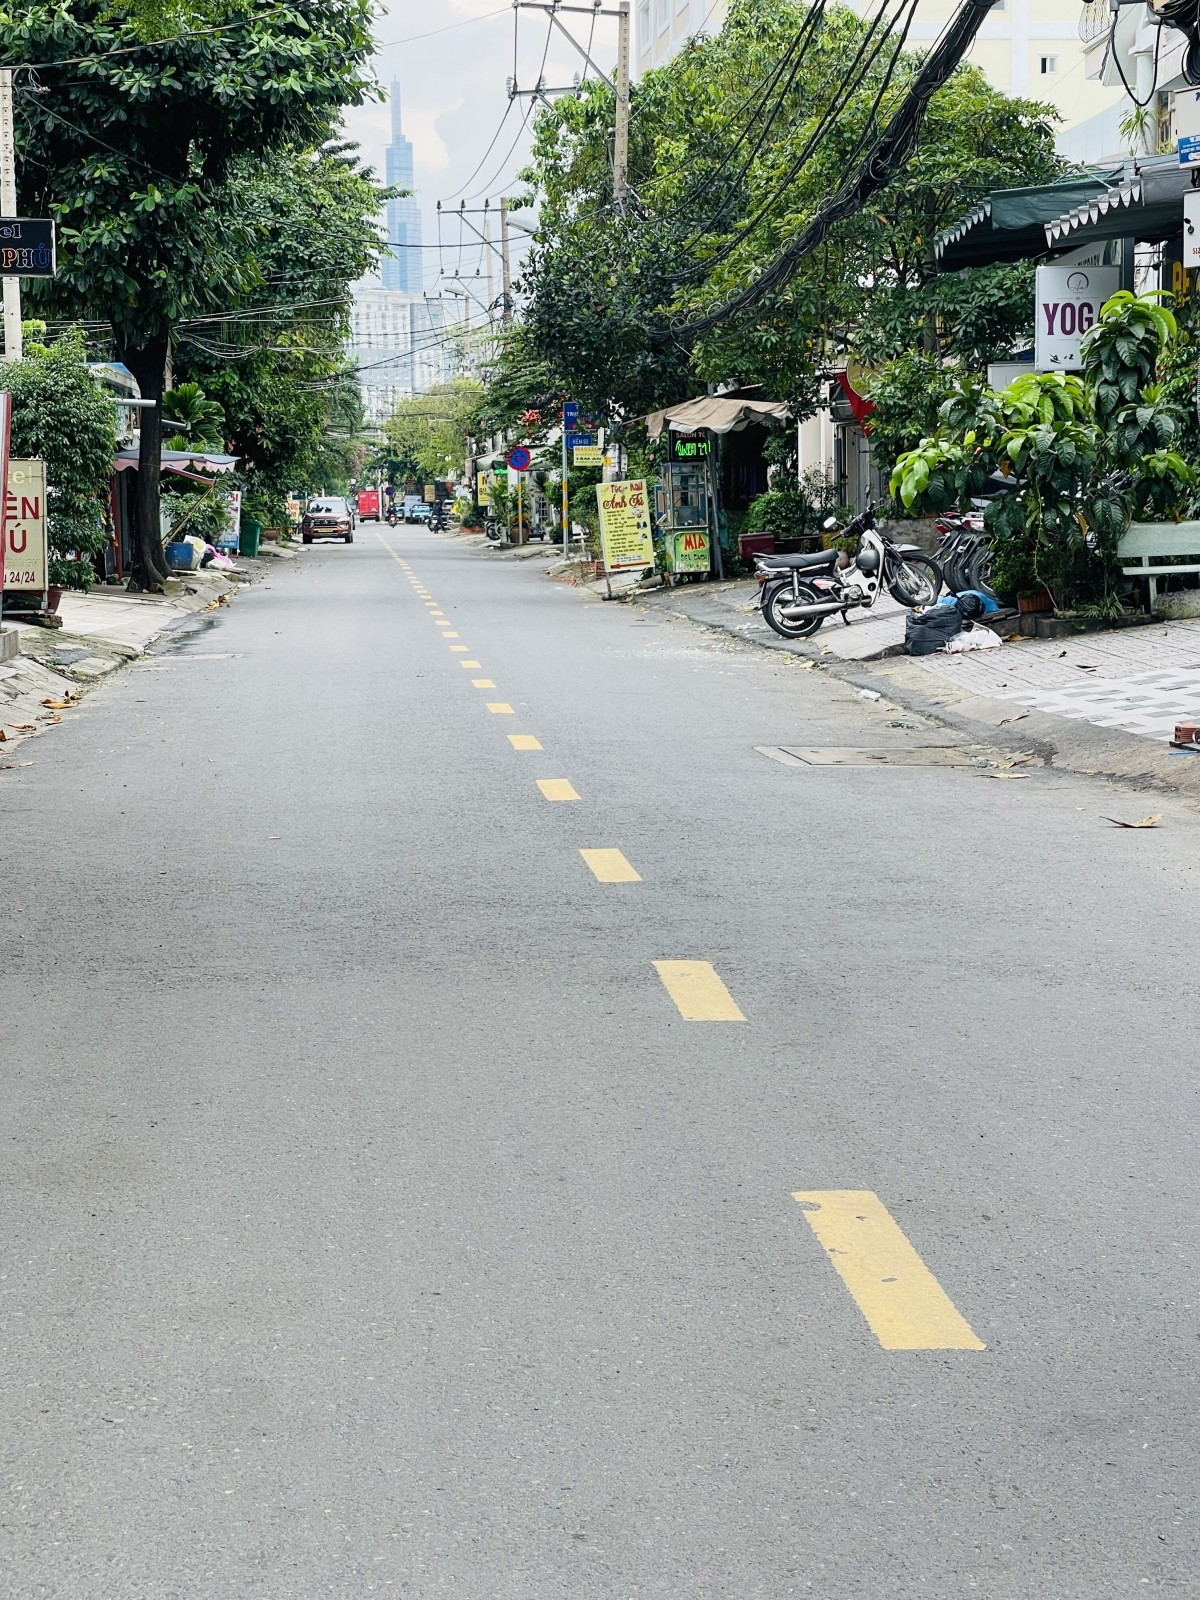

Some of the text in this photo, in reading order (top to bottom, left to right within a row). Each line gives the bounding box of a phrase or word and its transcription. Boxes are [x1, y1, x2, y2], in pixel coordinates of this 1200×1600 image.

[2, 242, 51, 269] PHÚ
[1042, 302, 1107, 336] YOG
[9, 570, 36, 585] 24/24
